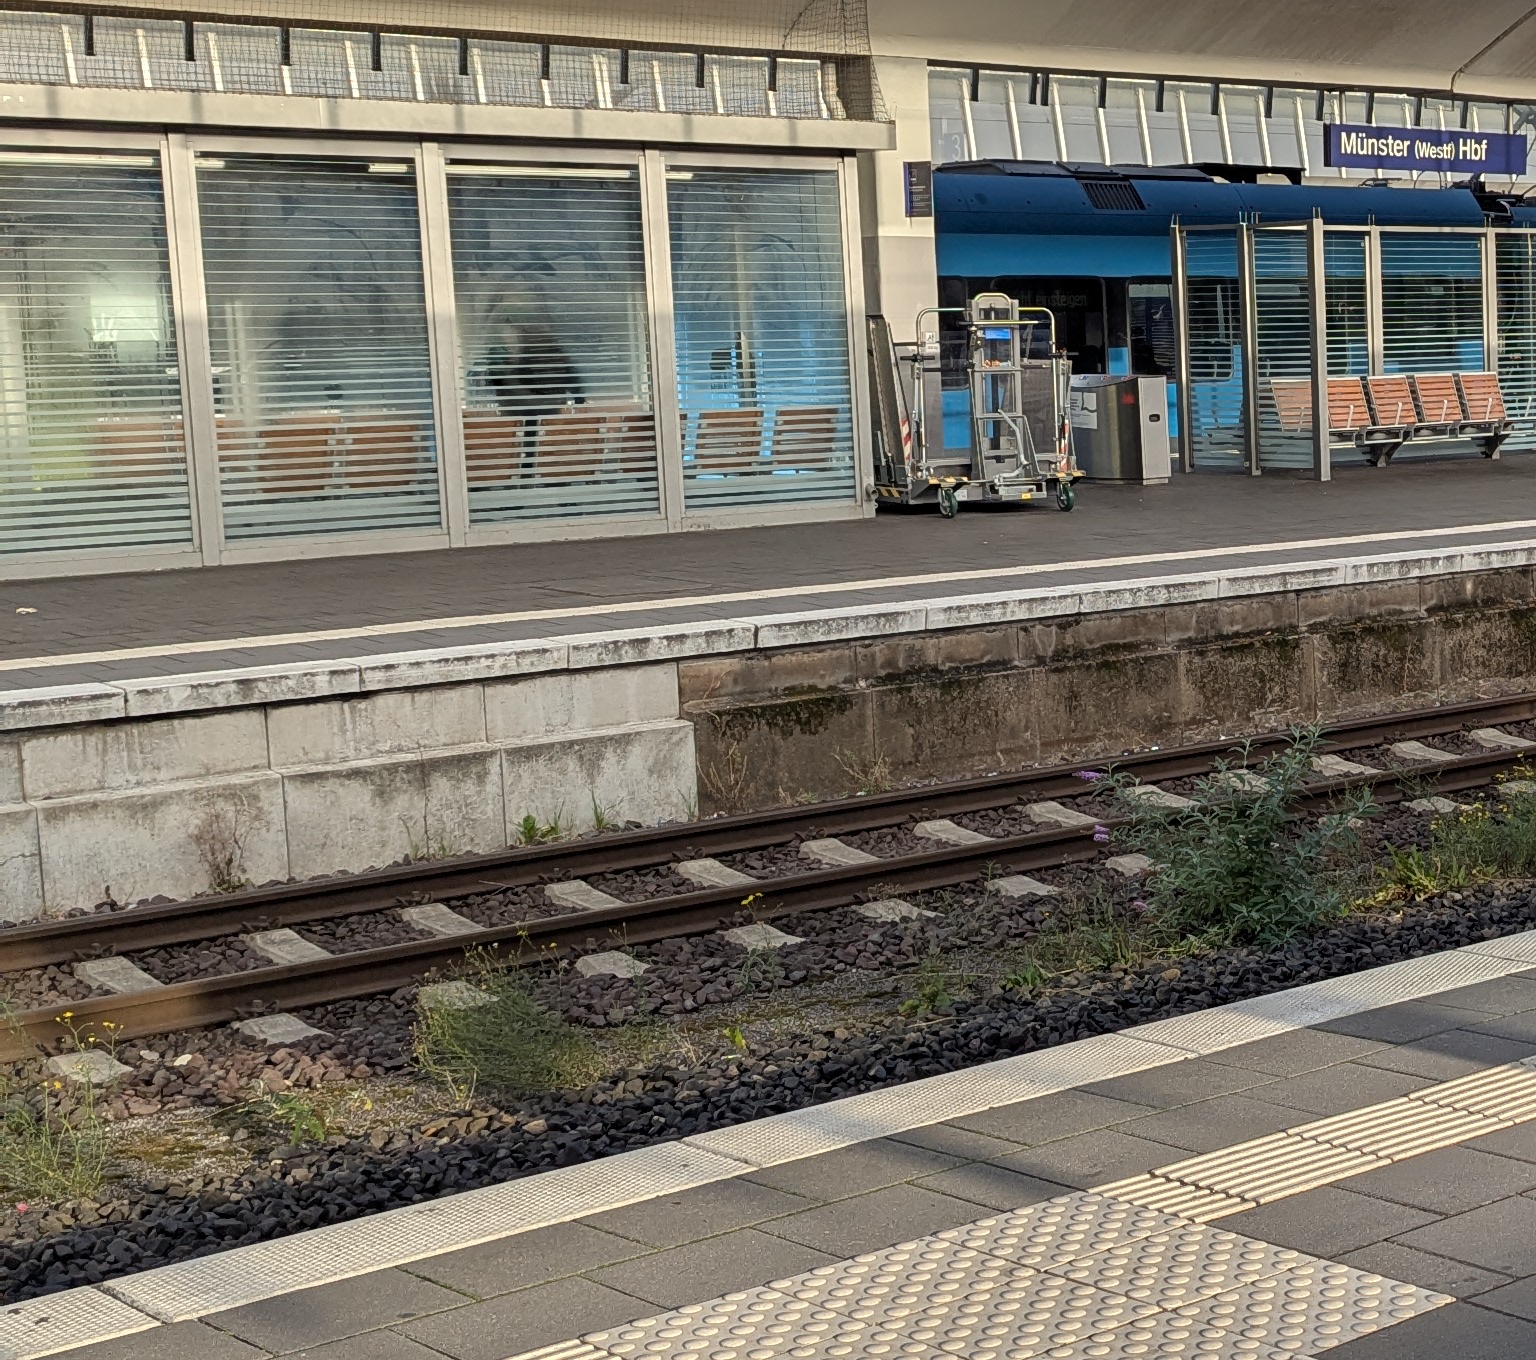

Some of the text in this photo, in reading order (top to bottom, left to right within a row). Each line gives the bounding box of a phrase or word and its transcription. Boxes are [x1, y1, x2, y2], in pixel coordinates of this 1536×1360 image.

[1340, 131, 1488, 161] Münster (Westf) Hbf
[1035, 290, 1088, 308] einsteigen
